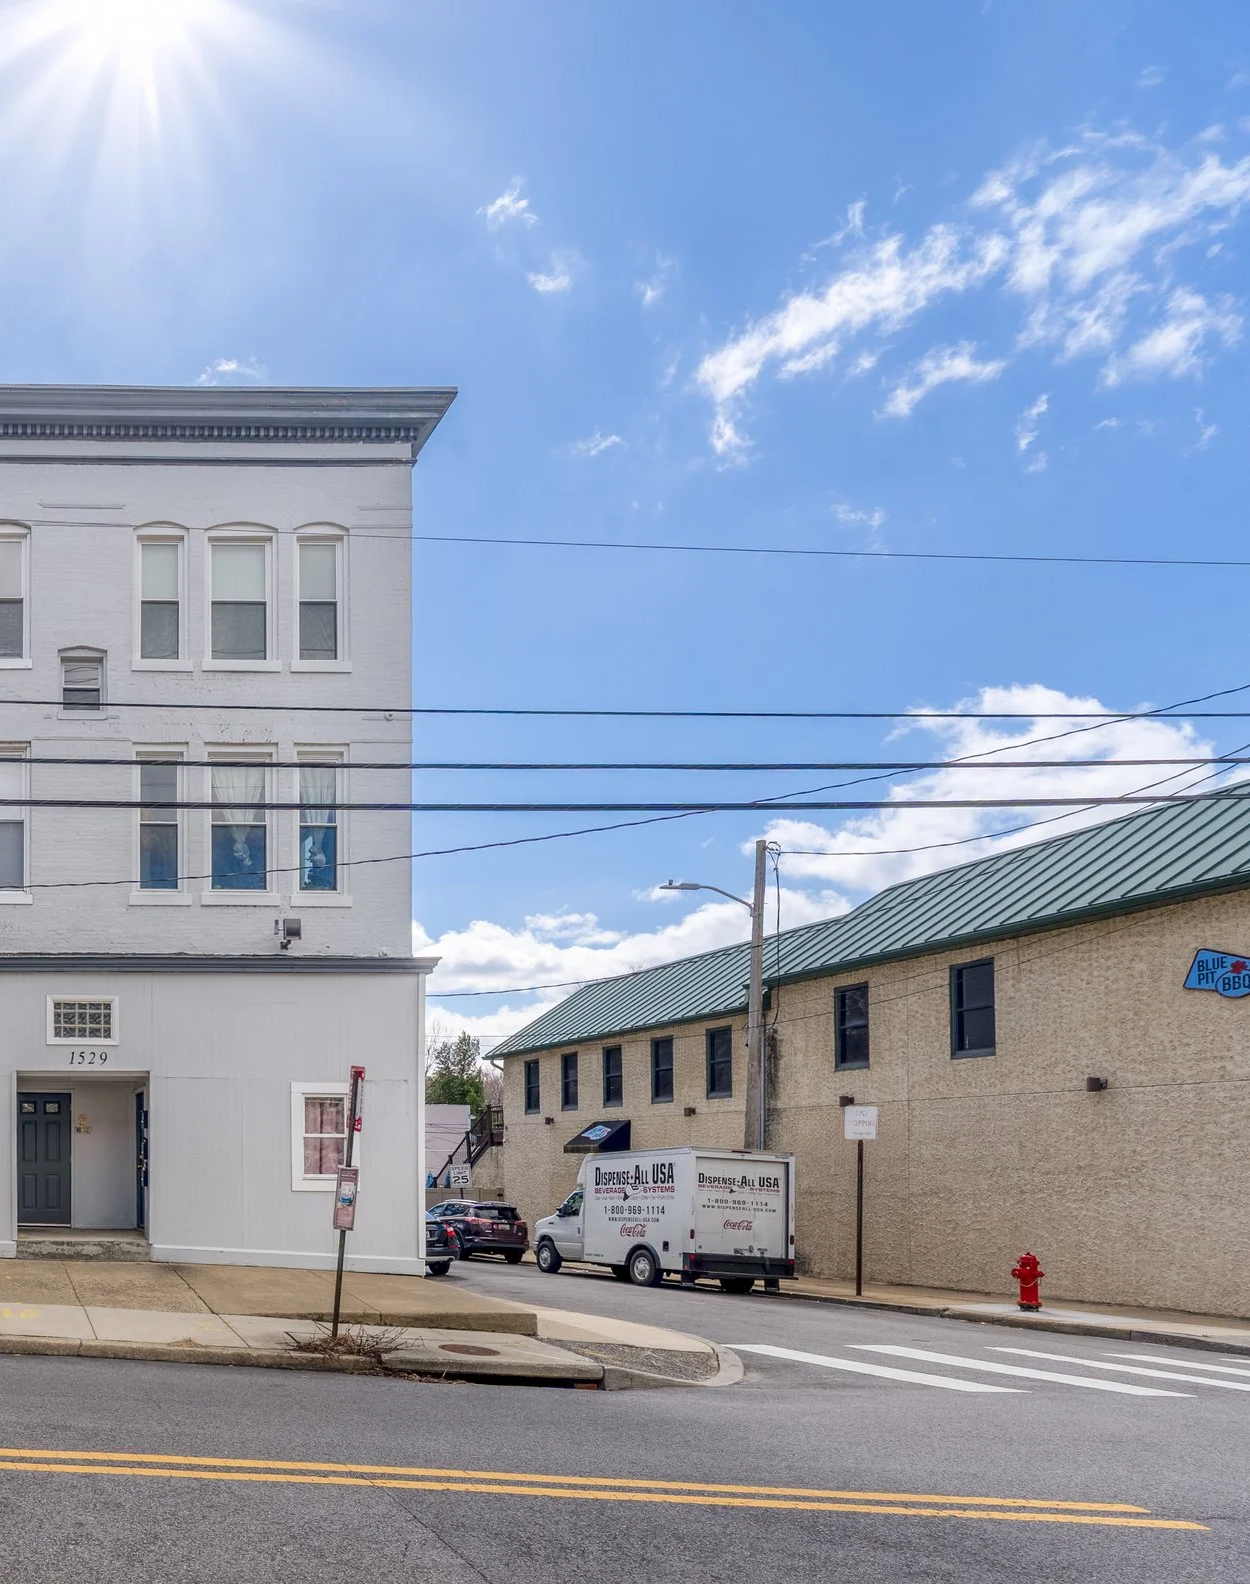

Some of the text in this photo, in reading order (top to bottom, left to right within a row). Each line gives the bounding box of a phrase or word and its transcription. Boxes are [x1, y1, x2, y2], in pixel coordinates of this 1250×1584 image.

[1197, 956, 1228, 972] BLUE
[1198, 971, 1216, 985] PIT
[1222, 974, 1250, 991] BBQ
[69, 1051, 107, 1065] 1529
[453, 1175, 469, 1183] 25
[652, 1163, 674, 1184] USA
[759, 1176, 779, 1188] USA
[604, 1206, 665, 1215] 1-800-969-1114
